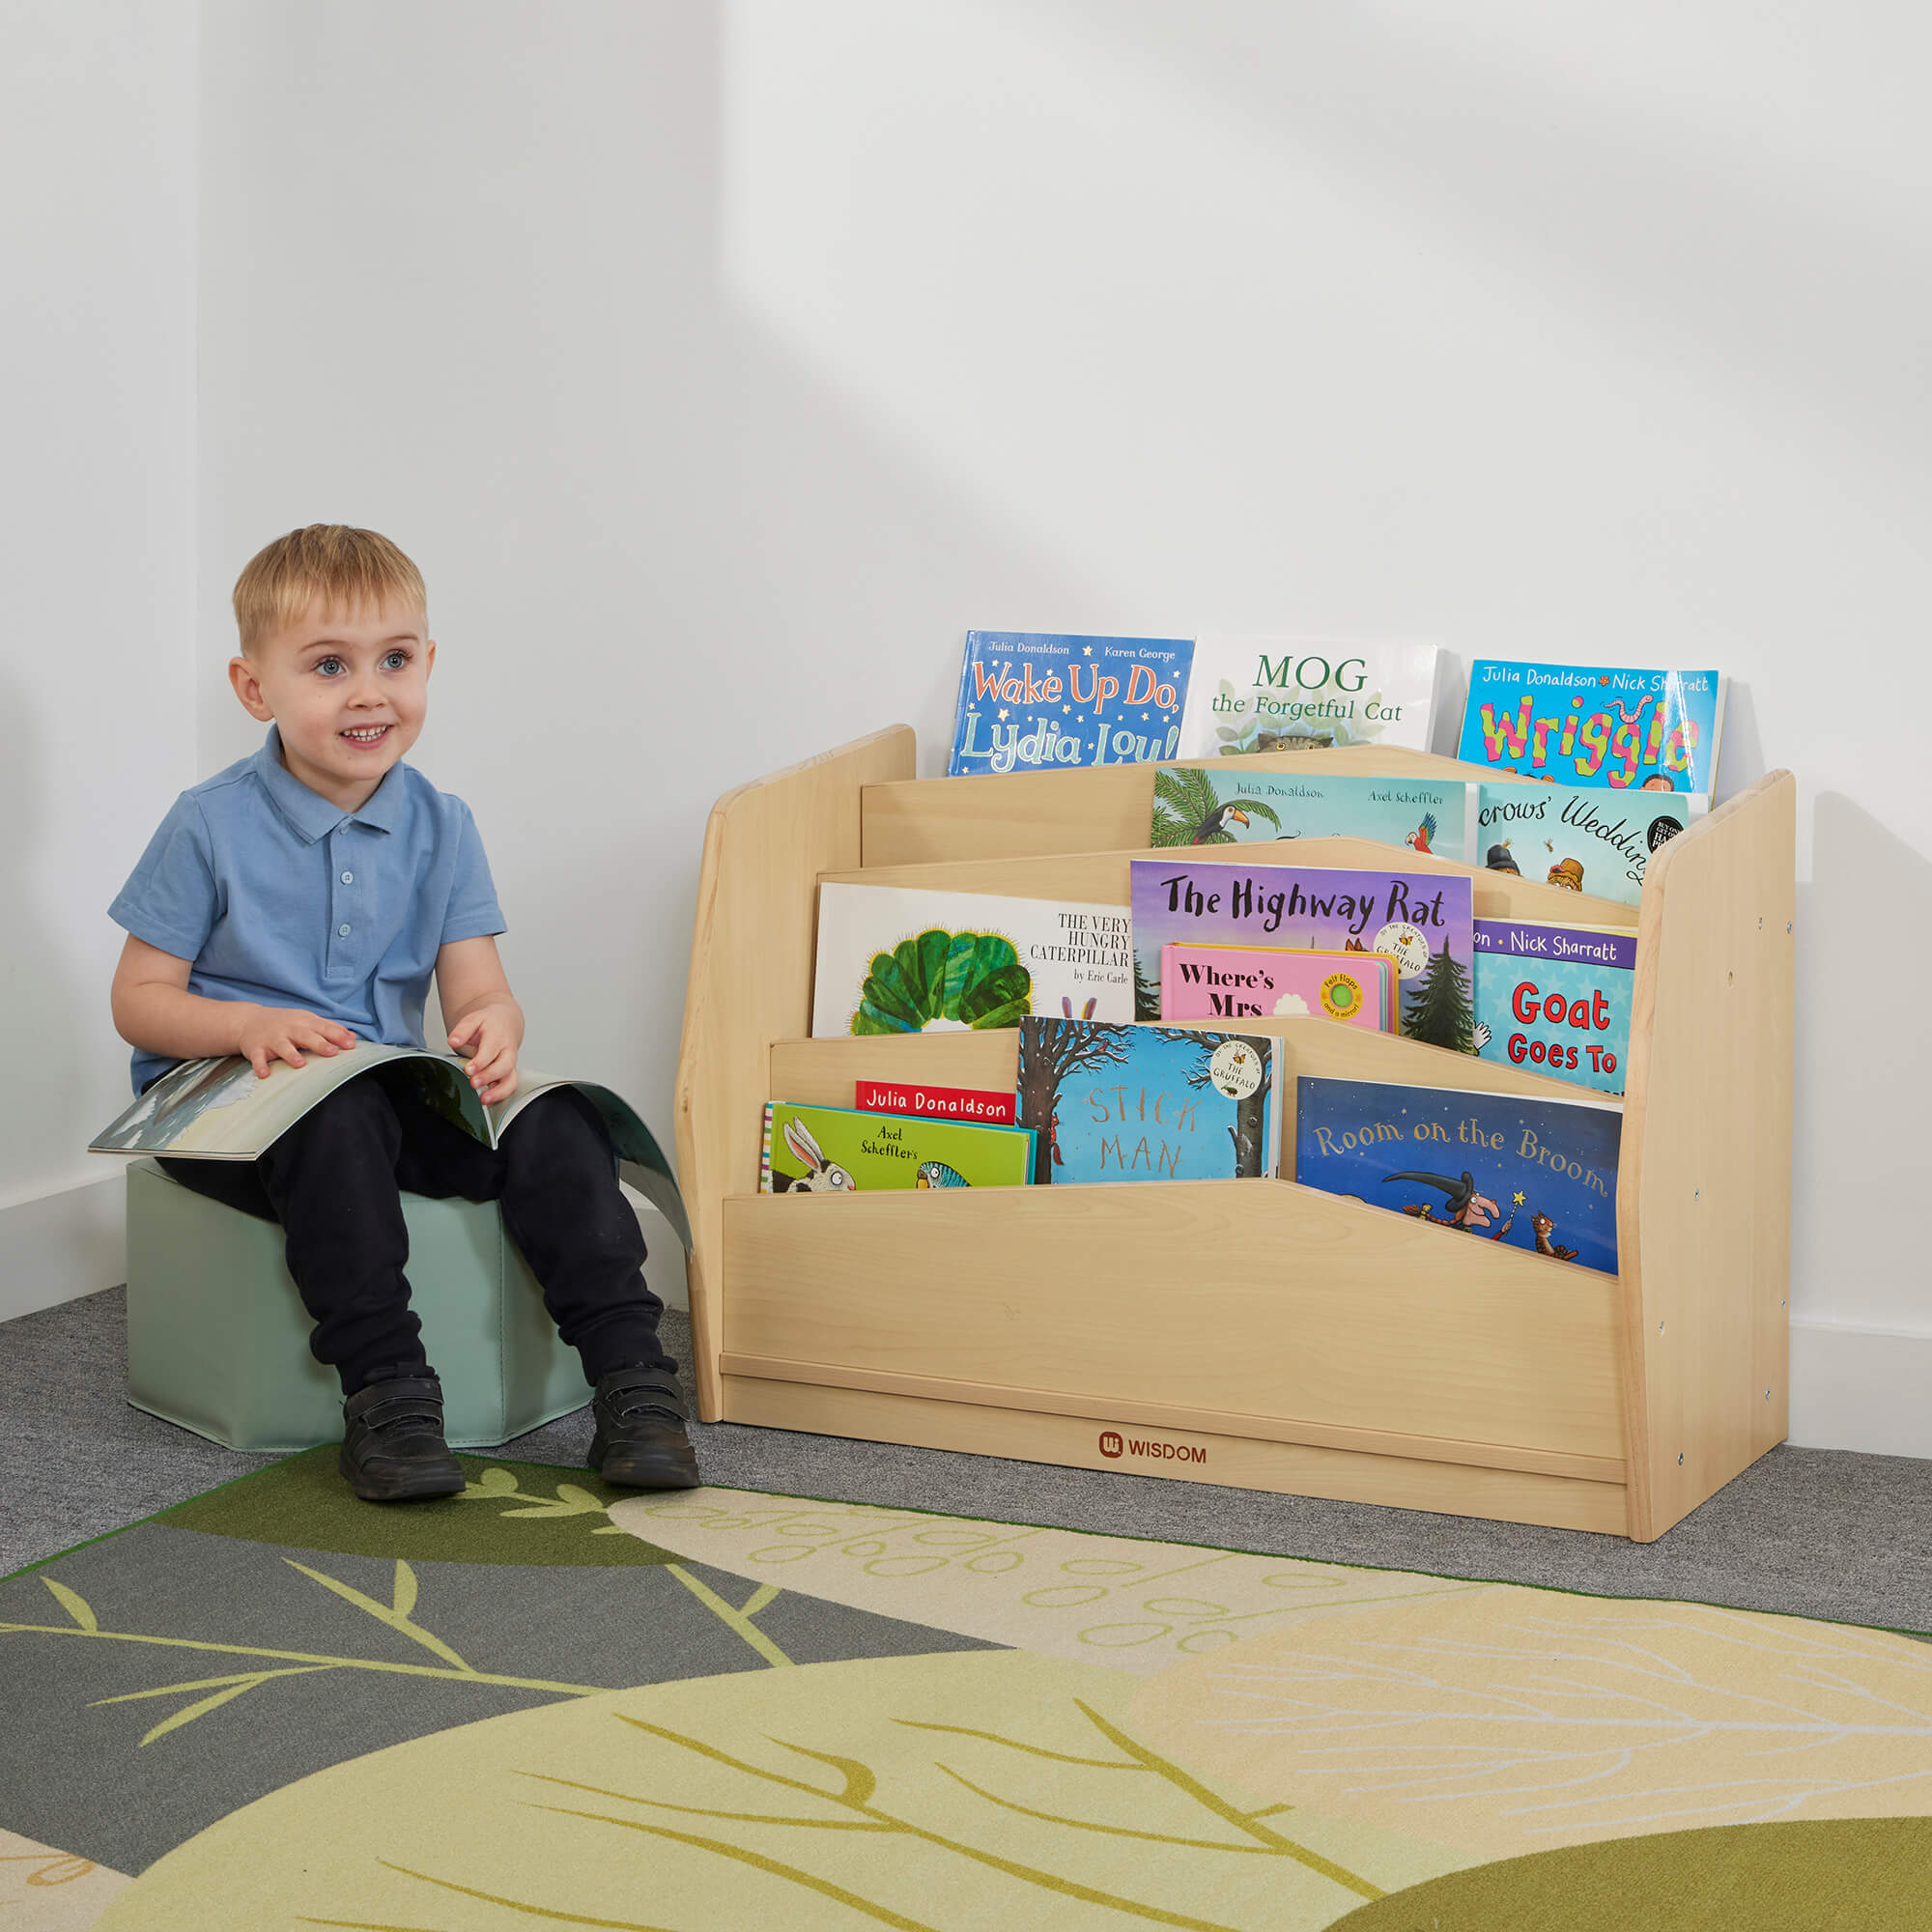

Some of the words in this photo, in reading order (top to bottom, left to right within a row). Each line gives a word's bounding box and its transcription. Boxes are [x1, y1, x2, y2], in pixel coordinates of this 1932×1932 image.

[988, 640, 1013, 653] Julia
[1017, 642, 1069, 655] Donaldson
[1105, 646, 1136, 658] Karen
[1139, 648, 1176, 663] George
[1252, 654, 1369, 693] MOG
[1482, 666, 1520, 683] Julia
[1526, 668, 1597, 688] Donaldson
[1611, 673, 1646, 691] Nick
[1649, 675, 1709, 692] Shratt
[972, 661, 1063, 704] Wake
[1068, 663, 1120, 715] Up
[1211, 694, 1246, 713] the
[1254, 696, 1355, 722] Forgetful
[1364, 702, 1404, 722] Cat
[960, 712, 1082, 773] Lydia
[1479, 695, 1700, 789] Wriggle
[1235, 781, 1262, 796] Julia
[1265, 784, 1324, 800] Donaldson
[1368, 790, 1392, 803] Axel
[1395, 791, 1444, 806] Scheffler
[1160, 875, 1221, 918] The
[1232, 878, 1375, 935] Highway
[1385, 880, 1445, 927] Rat
[1058, 913, 1088, 930] THE
[1092, 916, 1131, 934] VERY
[1067, 930, 1130, 951] HUNGRY
[1510, 930, 1548, 952] Nick
[1552, 935, 1617, 961] Sharratt
[1030, 944, 1128, 967] CATERPILLAR
[1073, 968, 1084, 983] by
[1087, 969, 1105, 982] Eric
[1106, 971, 1128, 984] Carle
[1179, 963, 1275, 990] Where's
[1208, 992, 1263, 1017] Mrs
[1512, 981, 1610, 1031] Goat
[1508, 1033, 1578, 1070] Goes
[1585, 1044, 1617, 1074] To
[1213, 1067, 1256, 1090] GRUFFALO
[1228, 1062, 1243, 1075] THE
[867, 1089, 907, 1109] Julia
[915, 1092, 1006, 1118] Donaldson
[1088, 1084, 1204, 1133] STICK
[877, 1124, 902, 1141] Axel
[1099, 1134, 1182, 1179] MAN
[1313, 1122, 1405, 1157] Room
[1413, 1122, 1451, 1144] on
[1458, 1118, 1505, 1151] the
[1516, 1128, 1608, 1198] Broom
[1128, 1438, 1207, 1464] WISDOM
